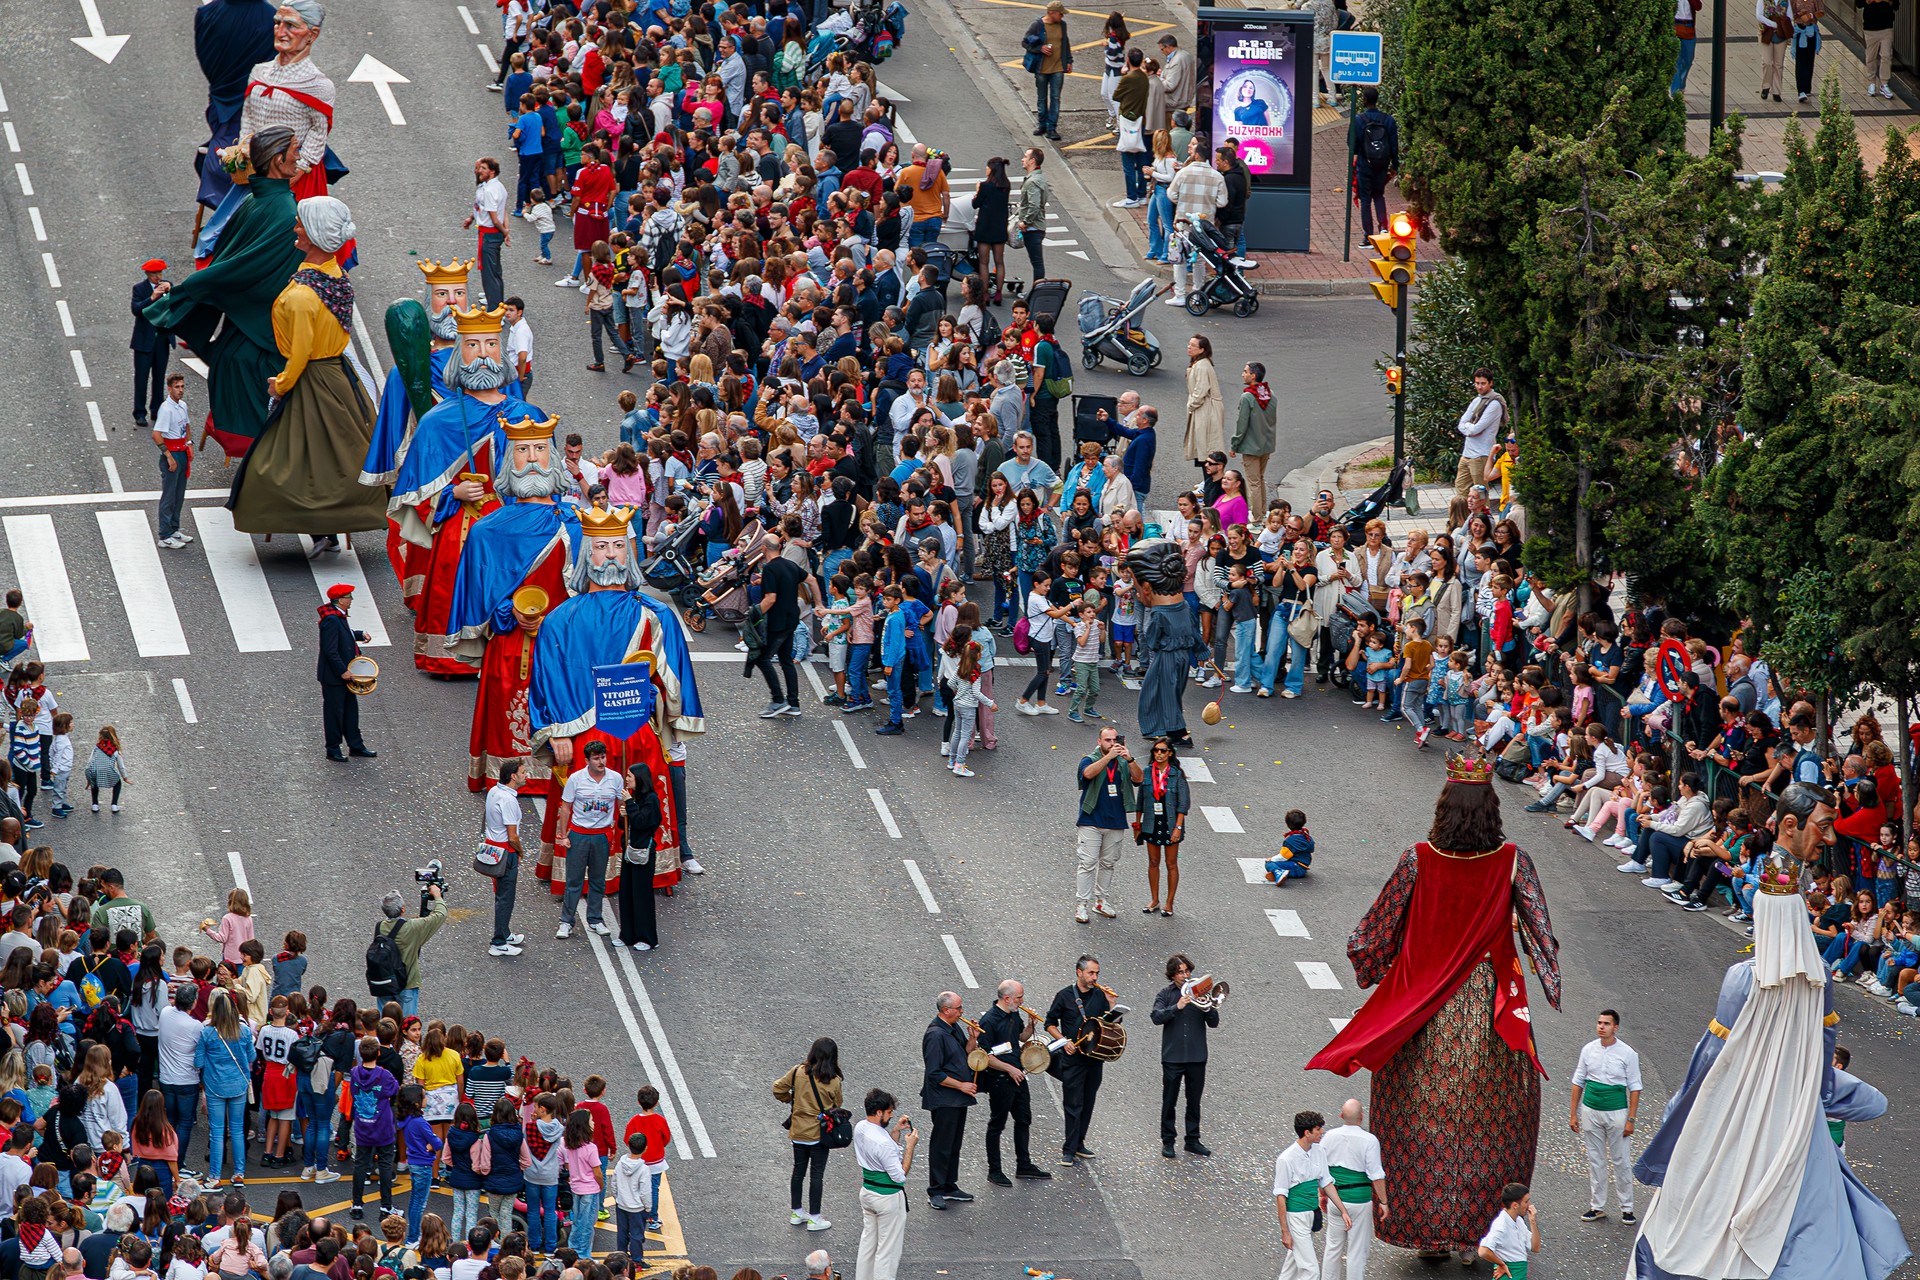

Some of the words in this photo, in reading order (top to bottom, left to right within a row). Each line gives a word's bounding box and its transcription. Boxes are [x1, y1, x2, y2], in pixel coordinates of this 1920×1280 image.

[1228, 46, 1283, 60] OCTUBRE
[1228, 126, 1282, 136] SUZYROXX
[604, 697, 641, 707] GASTEIZ
[263, 1036, 285, 1058] 86
